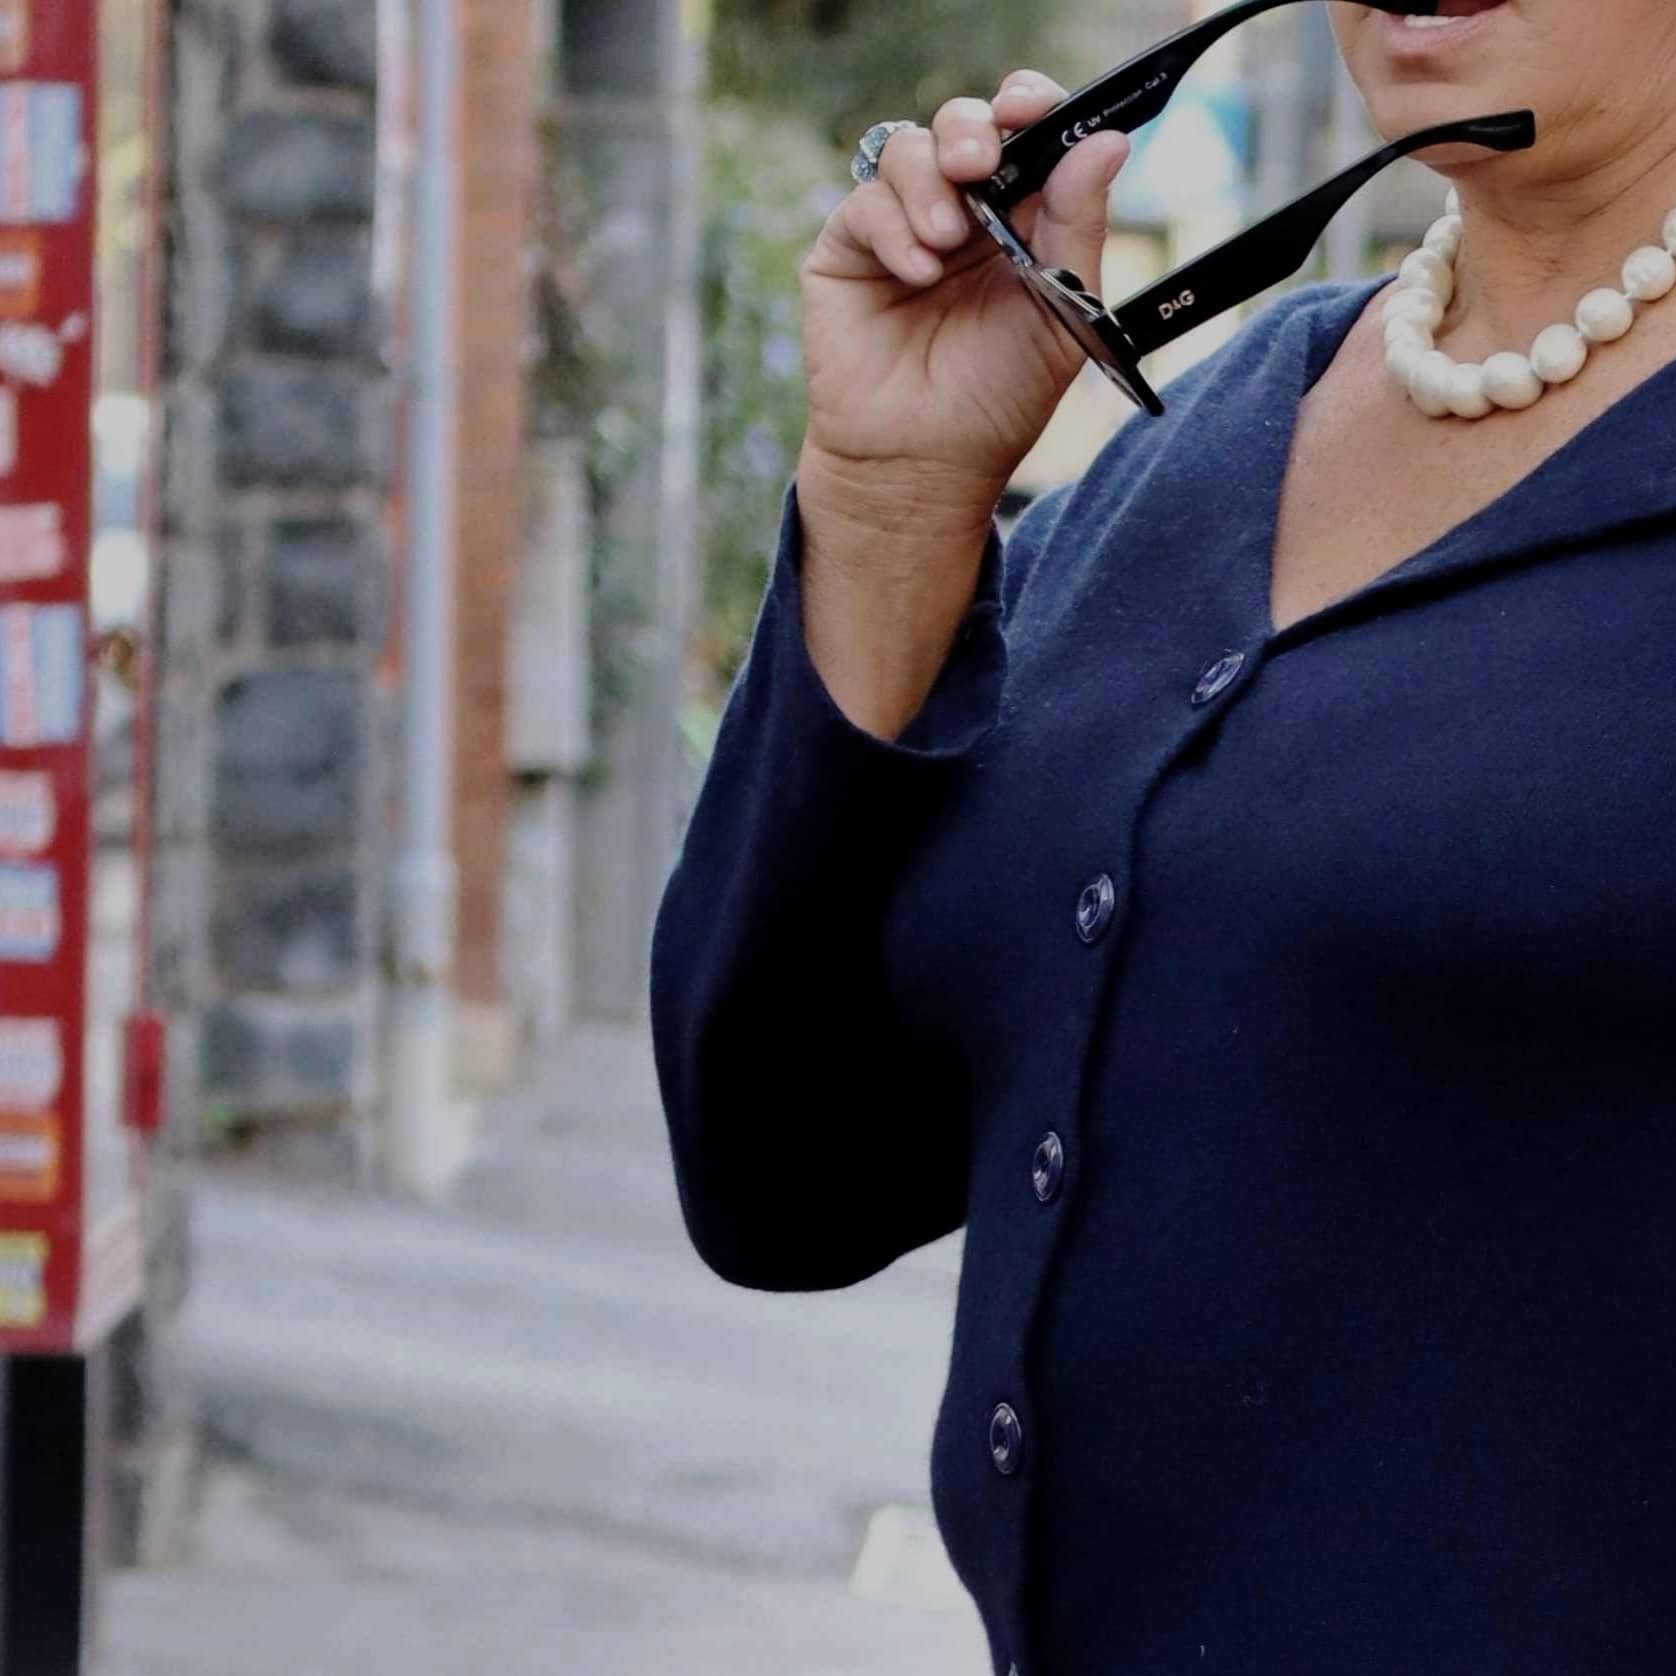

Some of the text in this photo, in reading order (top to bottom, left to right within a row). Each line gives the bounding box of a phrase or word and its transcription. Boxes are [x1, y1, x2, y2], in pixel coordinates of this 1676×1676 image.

[1061, 121, 1088, 147] CE
[1087, 114, 1101, 127] UV
[1158, 289, 1195, 320] D&G
